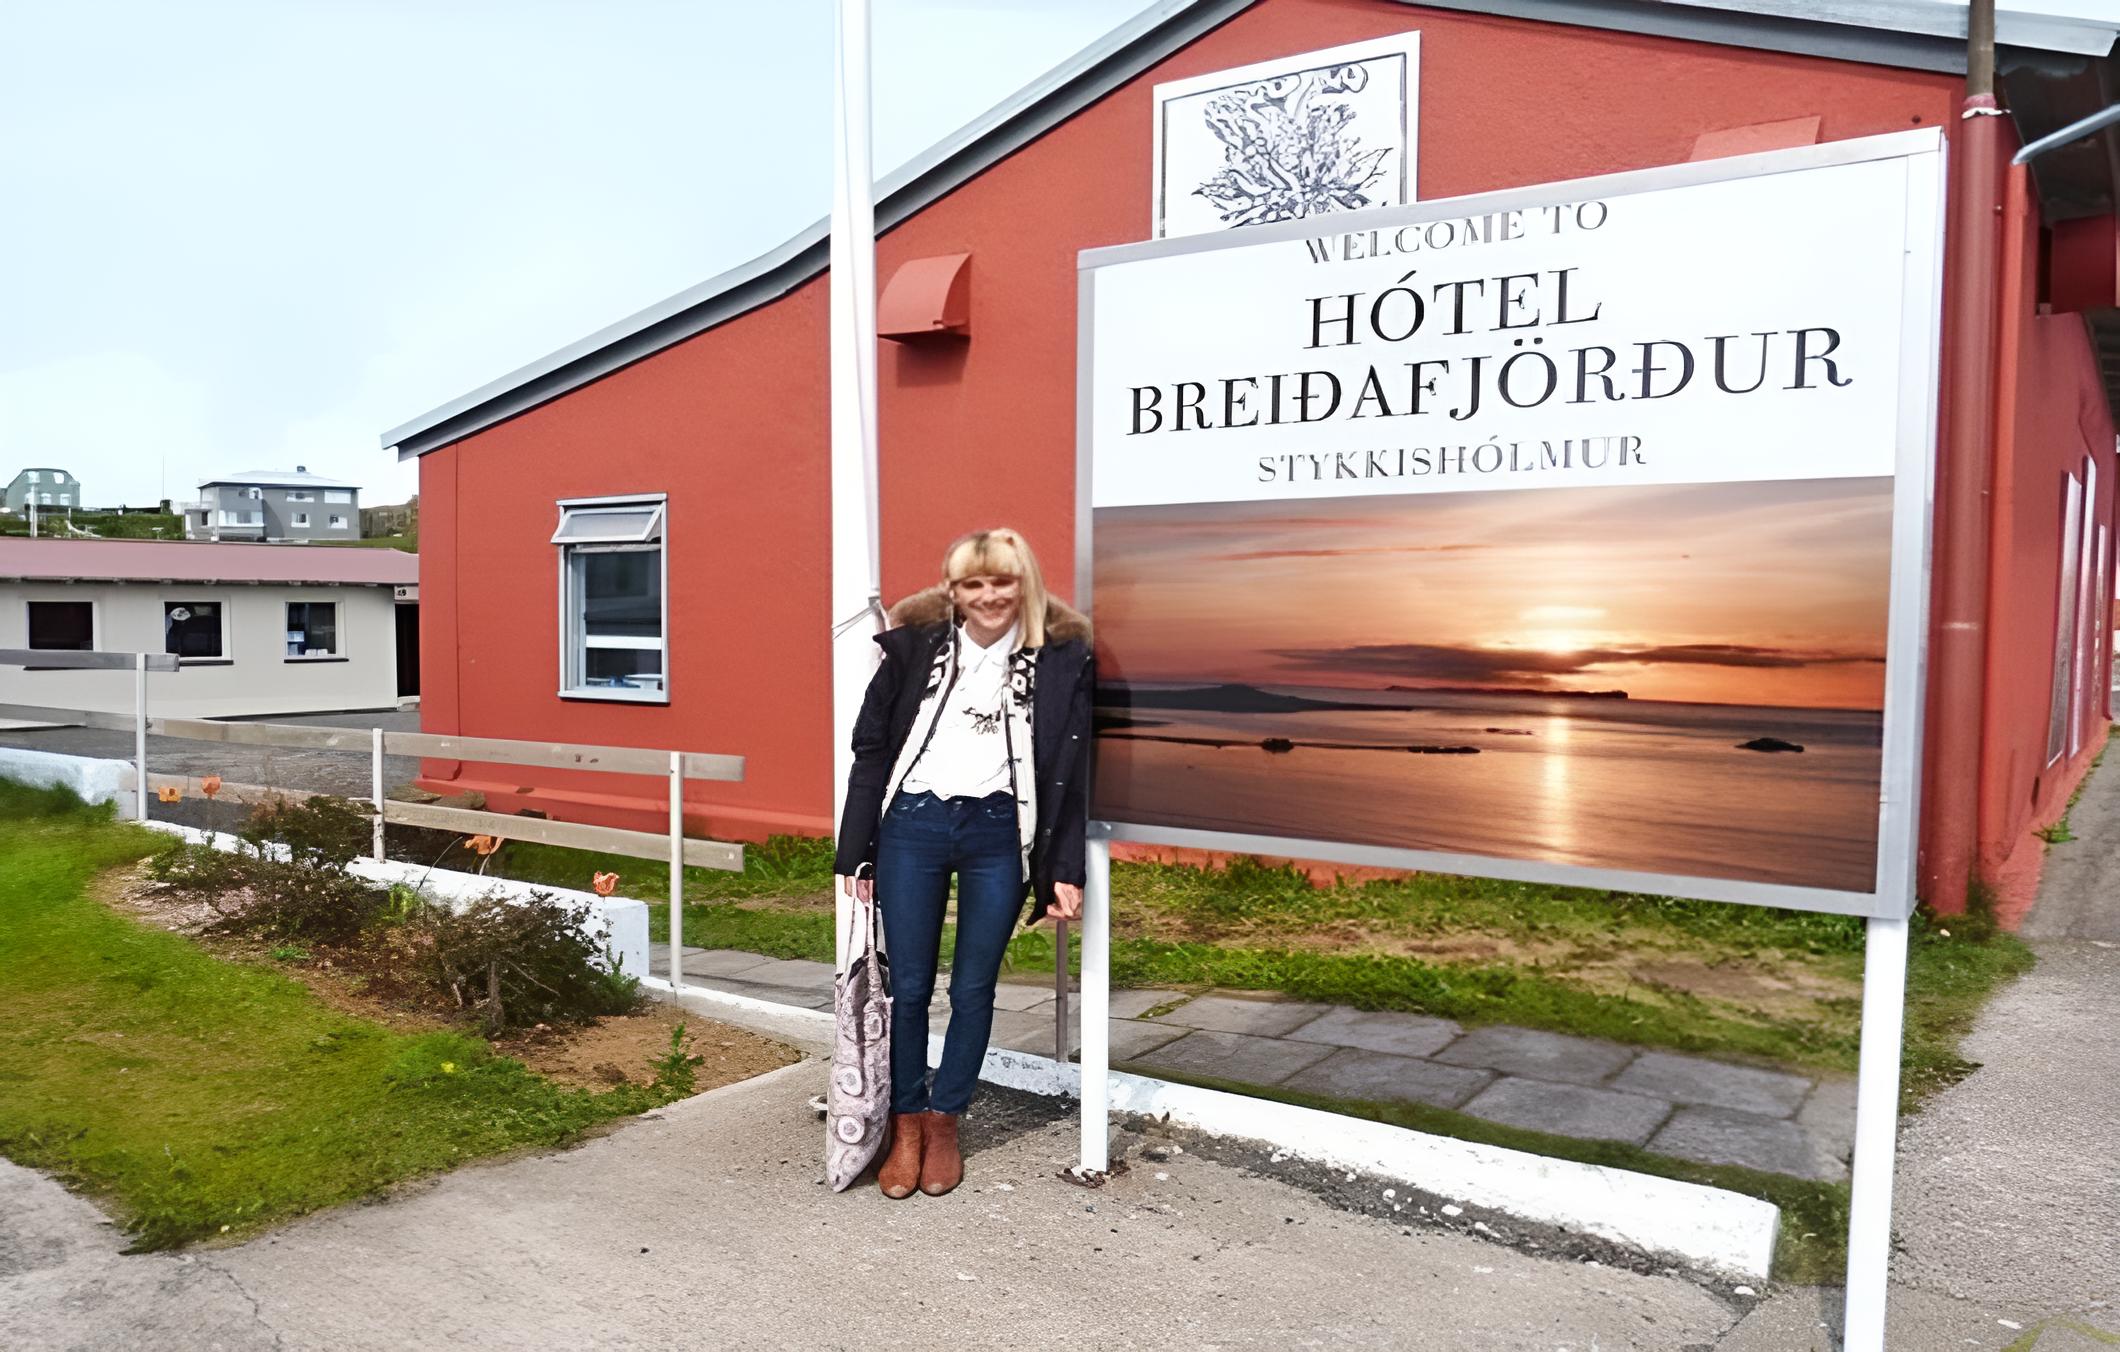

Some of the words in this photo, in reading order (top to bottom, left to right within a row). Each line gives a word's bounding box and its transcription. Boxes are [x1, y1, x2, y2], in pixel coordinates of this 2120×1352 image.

[1304, 209, 1526, 264] WELCOME
[1542, 200, 1609, 235] TO
[1302, 267, 1603, 350] HÓTEL
[1125, 327, 1855, 436] BREIÐAFJÖRÐUR
[1257, 434, 1648, 483] STYKKISHÓLMUR
